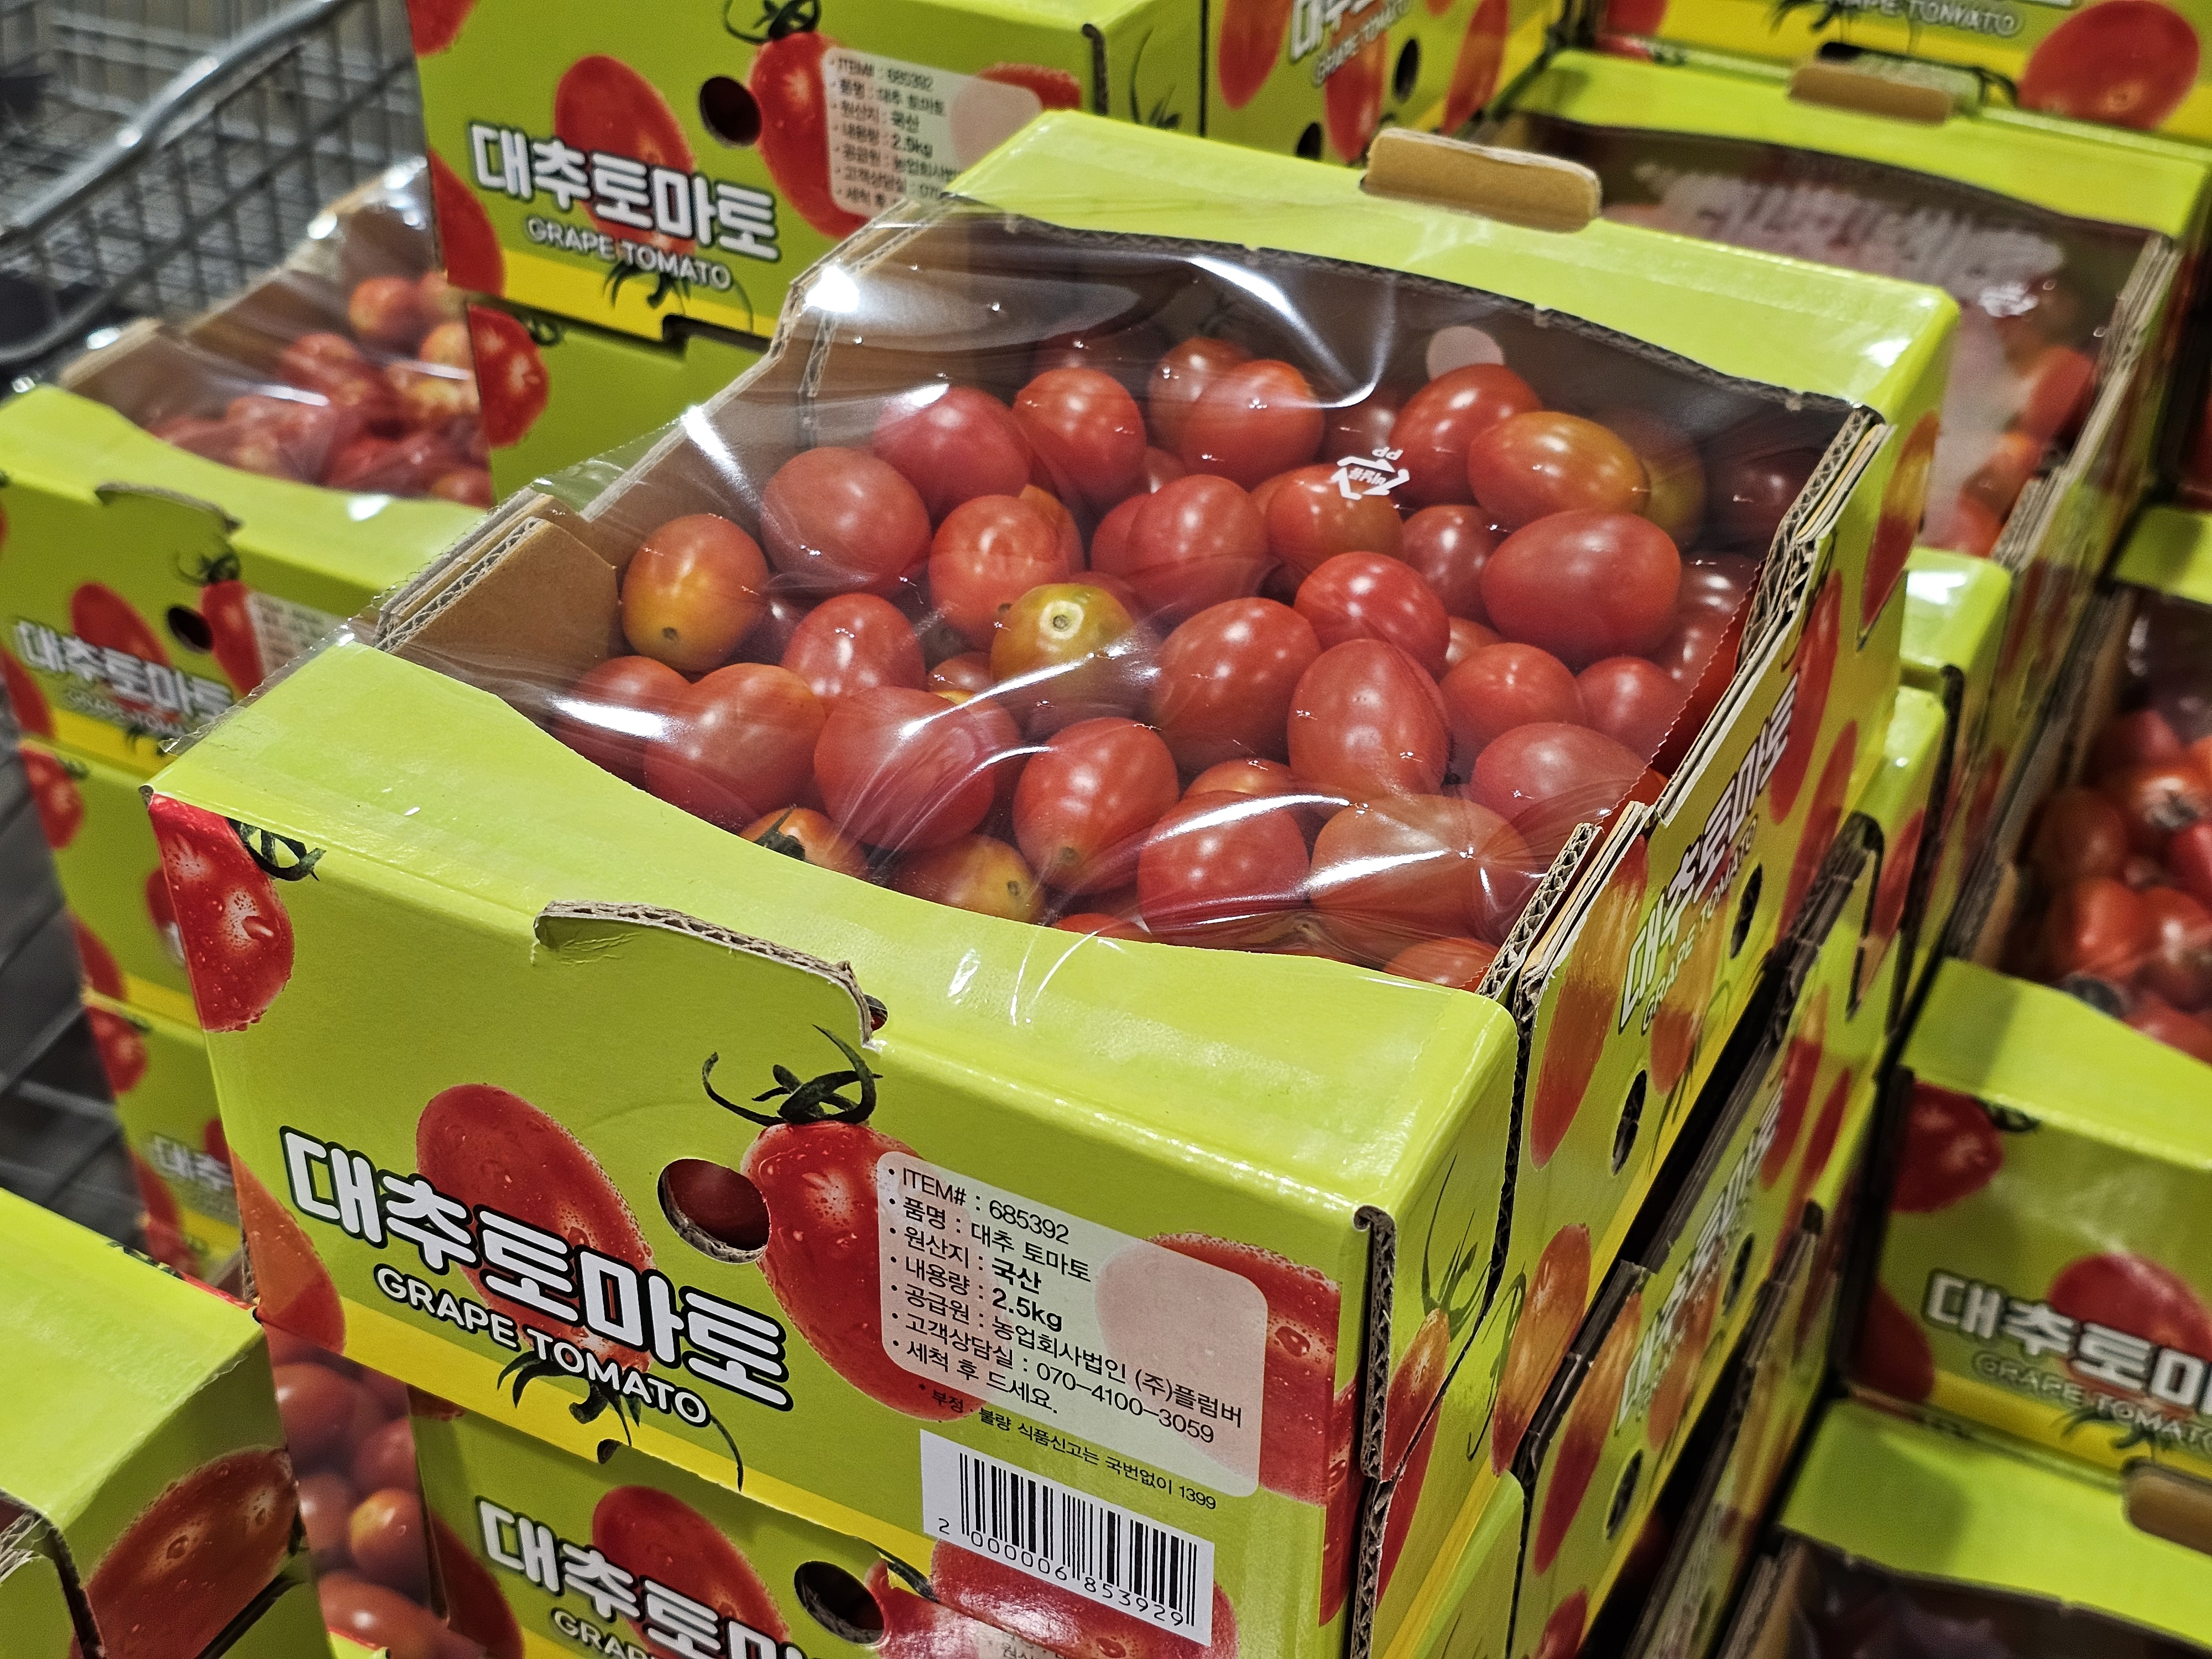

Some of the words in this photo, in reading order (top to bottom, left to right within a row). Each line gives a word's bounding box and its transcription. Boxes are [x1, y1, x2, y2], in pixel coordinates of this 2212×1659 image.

[470, 123, 780, 262] 대추토마토
[528, 219, 614, 260] GRAPE
[622, 243, 732, 290] TOMATO
[1372, 446, 1404, 461] PP
[1618, 671, 1798, 1032] 대추토마토
[1642, 922, 1696, 1034] GRAPE
[1700, 815, 1759, 931] TOMATO
[903, 1167, 967, 1206] ITEM#
[989, 1200, 1070, 1244] 685392
[903, 1197, 947, 1230] 품명
[971, 1220, 1015, 1253] 대추
[1022, 1241, 1092, 1282] 토마토
[904, 1226, 971, 1269] 원산지
[991, 1257, 1042, 1295] 국산
[281, 1127, 792, 1410] 대추토마토
[905, 1258, 970, 1296] 내용량
[992, 1288, 1063, 1333] 2.5kg
[376, 1265, 519, 1349] GRAPE
[525, 1330, 710, 1425] TOMATO
[905, 1286, 970, 1325] 공급원
[992, 1316, 1126, 1384] 농업회사법인
[1135, 1368, 1243, 1428] (주)플럼버
[906, 1313, 1014, 1370] 고객상담실
[1037, 1362, 1214, 1444] 070-4100-3059
[907, 1341, 950, 1373] 세척
[957, 1358, 979, 1381] 후
[987, 1371, 1058, 1414] 드세요.
[932, 1388, 964, 1414] 부정
[979, 1407, 1012, 1432] 불량
[1018, 1422, 1100, 1465] 식품신고는
[1105, 1456, 1172, 1495] 국번없이
[1179, 1485, 1217, 1510] 1399
[938, 1517, 951, 1535] 2
[971, 1531, 1068, 1582] 000006
[1084, 1577, 1184, 1627] 853929
